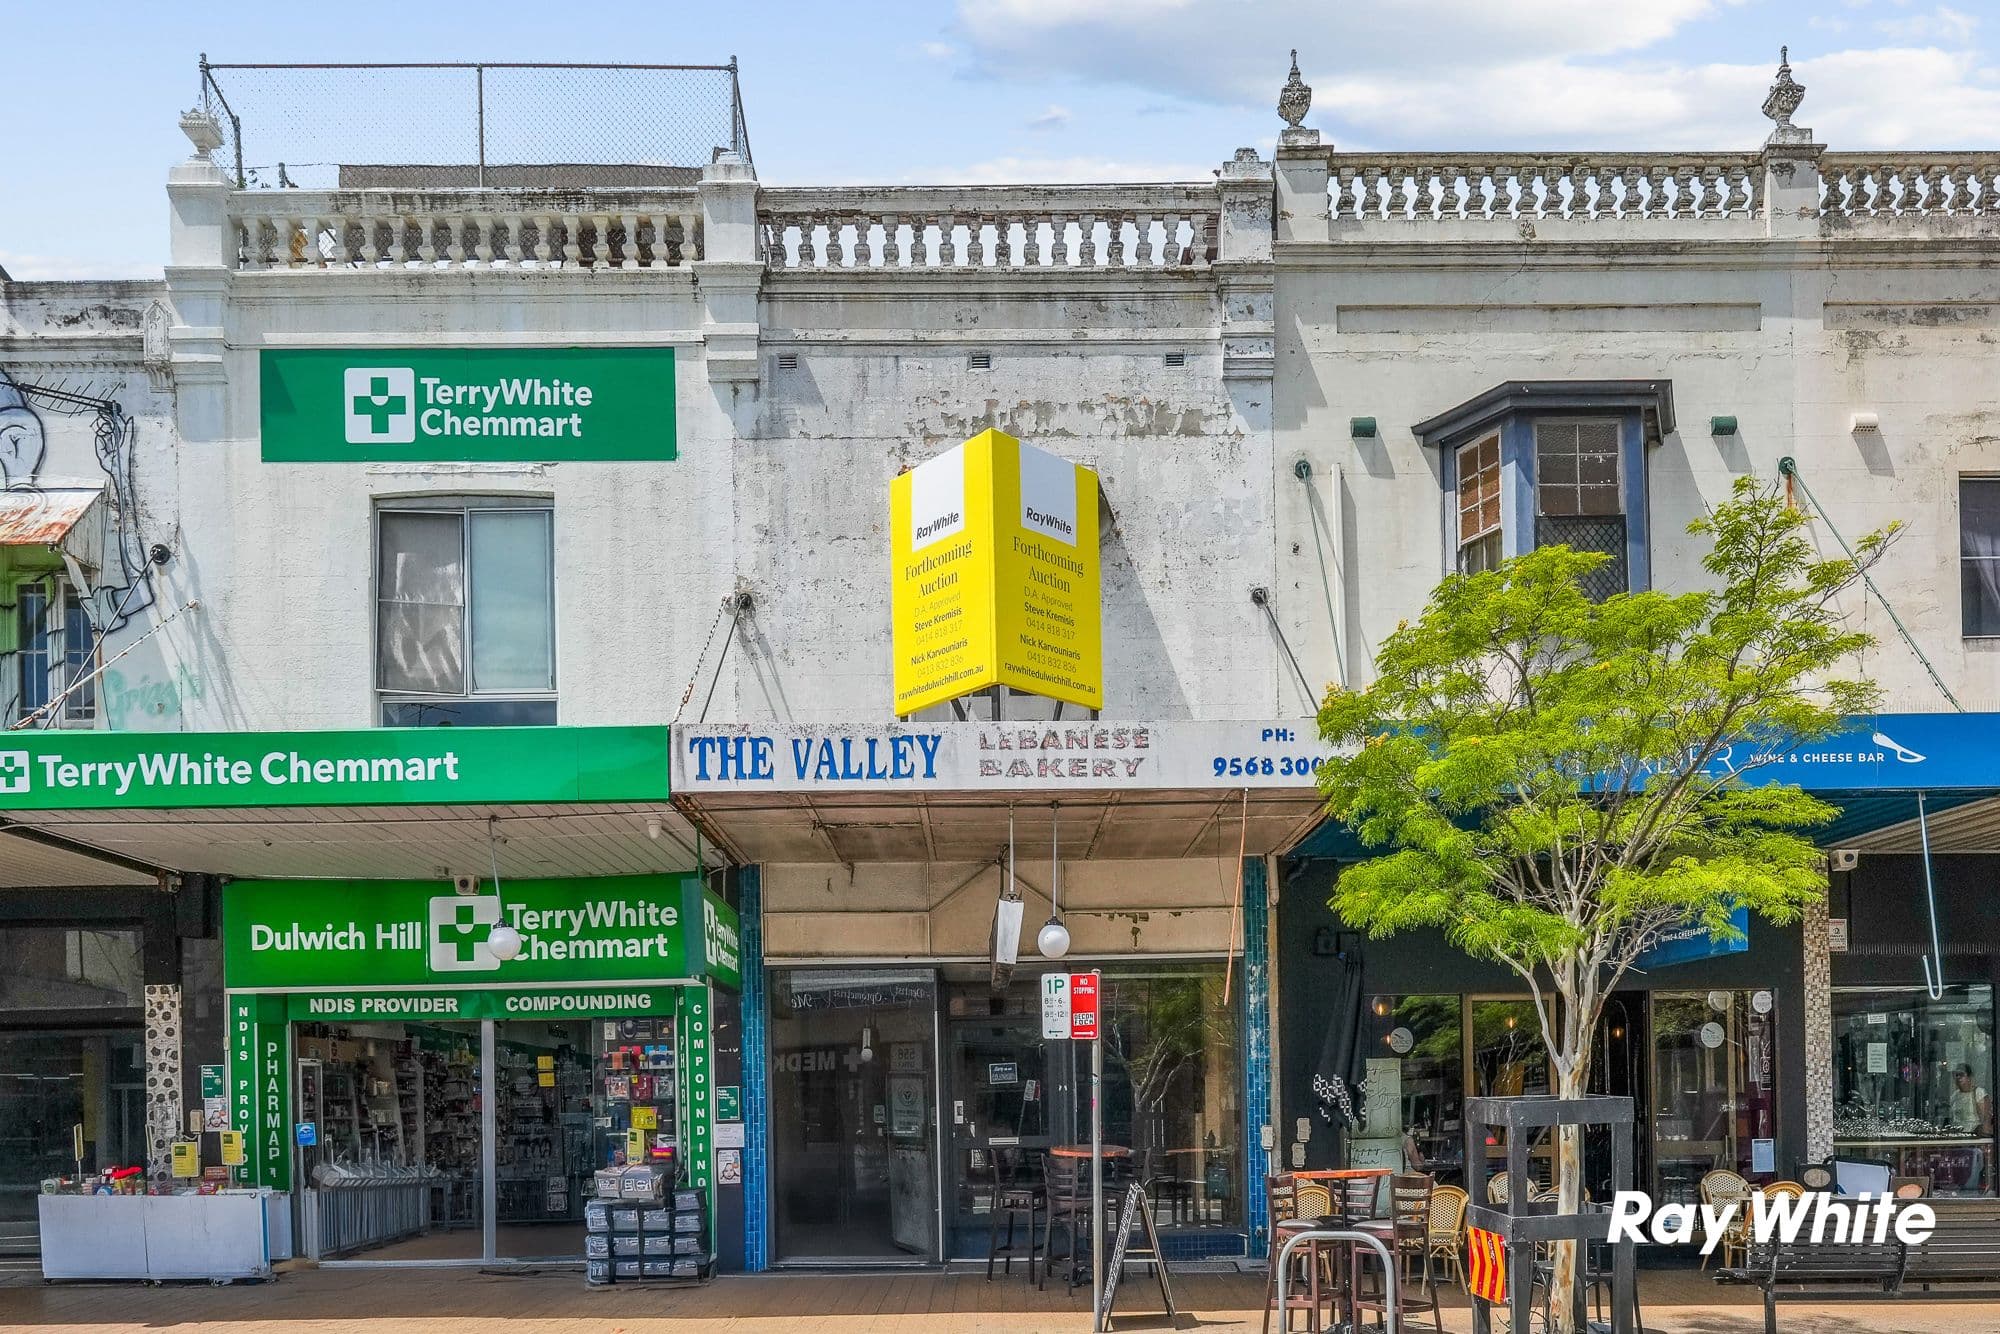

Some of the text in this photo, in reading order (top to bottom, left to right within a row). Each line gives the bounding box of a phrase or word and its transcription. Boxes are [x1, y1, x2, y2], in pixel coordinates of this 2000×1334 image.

[420, 377, 592, 415] TerryWhite
[420, 407, 581, 437] Chemmart
[905, 540, 972, 581] Forthcoming
[1013, 536, 1084, 578] Forthcoming
[918, 570, 958, 598] Auction
[1029, 566, 1070, 593] Auction
[1024, 601, 1075, 627] Steve Kremisis
[1041, 593, 1073, 611] Approved
[915, 620, 932, 633] Steve
[1026, 617, 1075, 640] 0414 818 317
[911, 654, 925, 666] Nick
[1020, 633, 1081, 660] Nick Karvouniaris
[1027, 651, 1045, 665] 0413
[1047, 657, 1061, 668] 832
[898, 665, 984, 700] raywhitedulwichhill.com.au
[1004, 662, 1096, 694] raywhitedulwichhill.com.au
[978, 728, 1151, 750] LEBANESE
[1262, 728, 1294, 741] PH:
[689, 735, 942, 781] THE VALLEY
[979, 757, 1146, 779] BAKERY
[1213, 756, 1274, 777] 9568
[1750, 754, 1785, 763] WINE
[1790, 753, 1798, 763] &
[1803, 752, 1853, 763] CHEESE
[1858, 752, 1885, 762] BAR
[38, 751, 458, 796] TerryWhite Chemmart
[507, 901, 677, 937] TerryWhite
[252, 922, 421, 952] Dulwich Hill
[514, 932, 668, 961] Chemmart
[1046, 979, 1065, 994] 1P
[1080, 978, 1088, 986] NO
[310, 997, 458, 1013] NDIS PROVIDER
[506, 994, 651, 1012] COMPOUNDING
[239, 1007, 249, 1060] NDIS
[693, 1004, 707, 1187] COMPOUNDING
